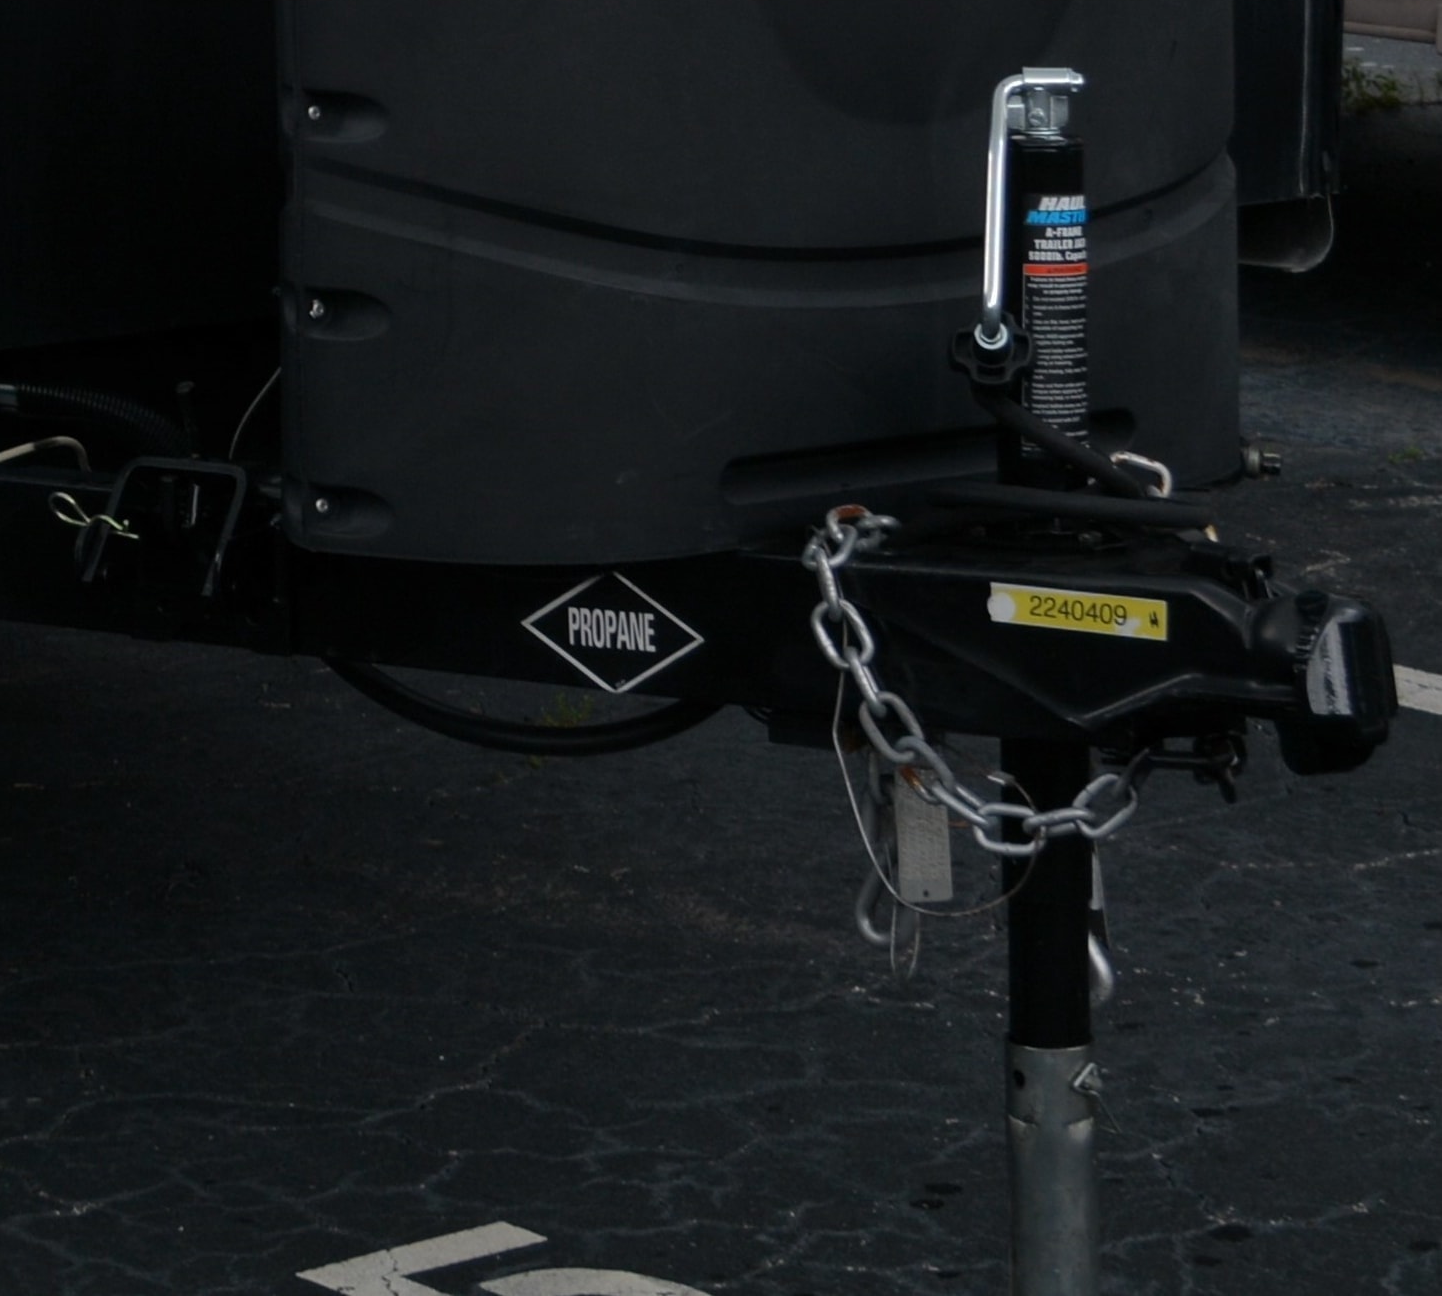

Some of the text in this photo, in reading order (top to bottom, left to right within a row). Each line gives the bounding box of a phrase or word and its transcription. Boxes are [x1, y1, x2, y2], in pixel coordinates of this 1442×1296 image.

[1033, 238, 1073, 250] TRAILER
[1028, 594, 1128, 626] 2240409
[567, 606, 657, 653] PROPANE
